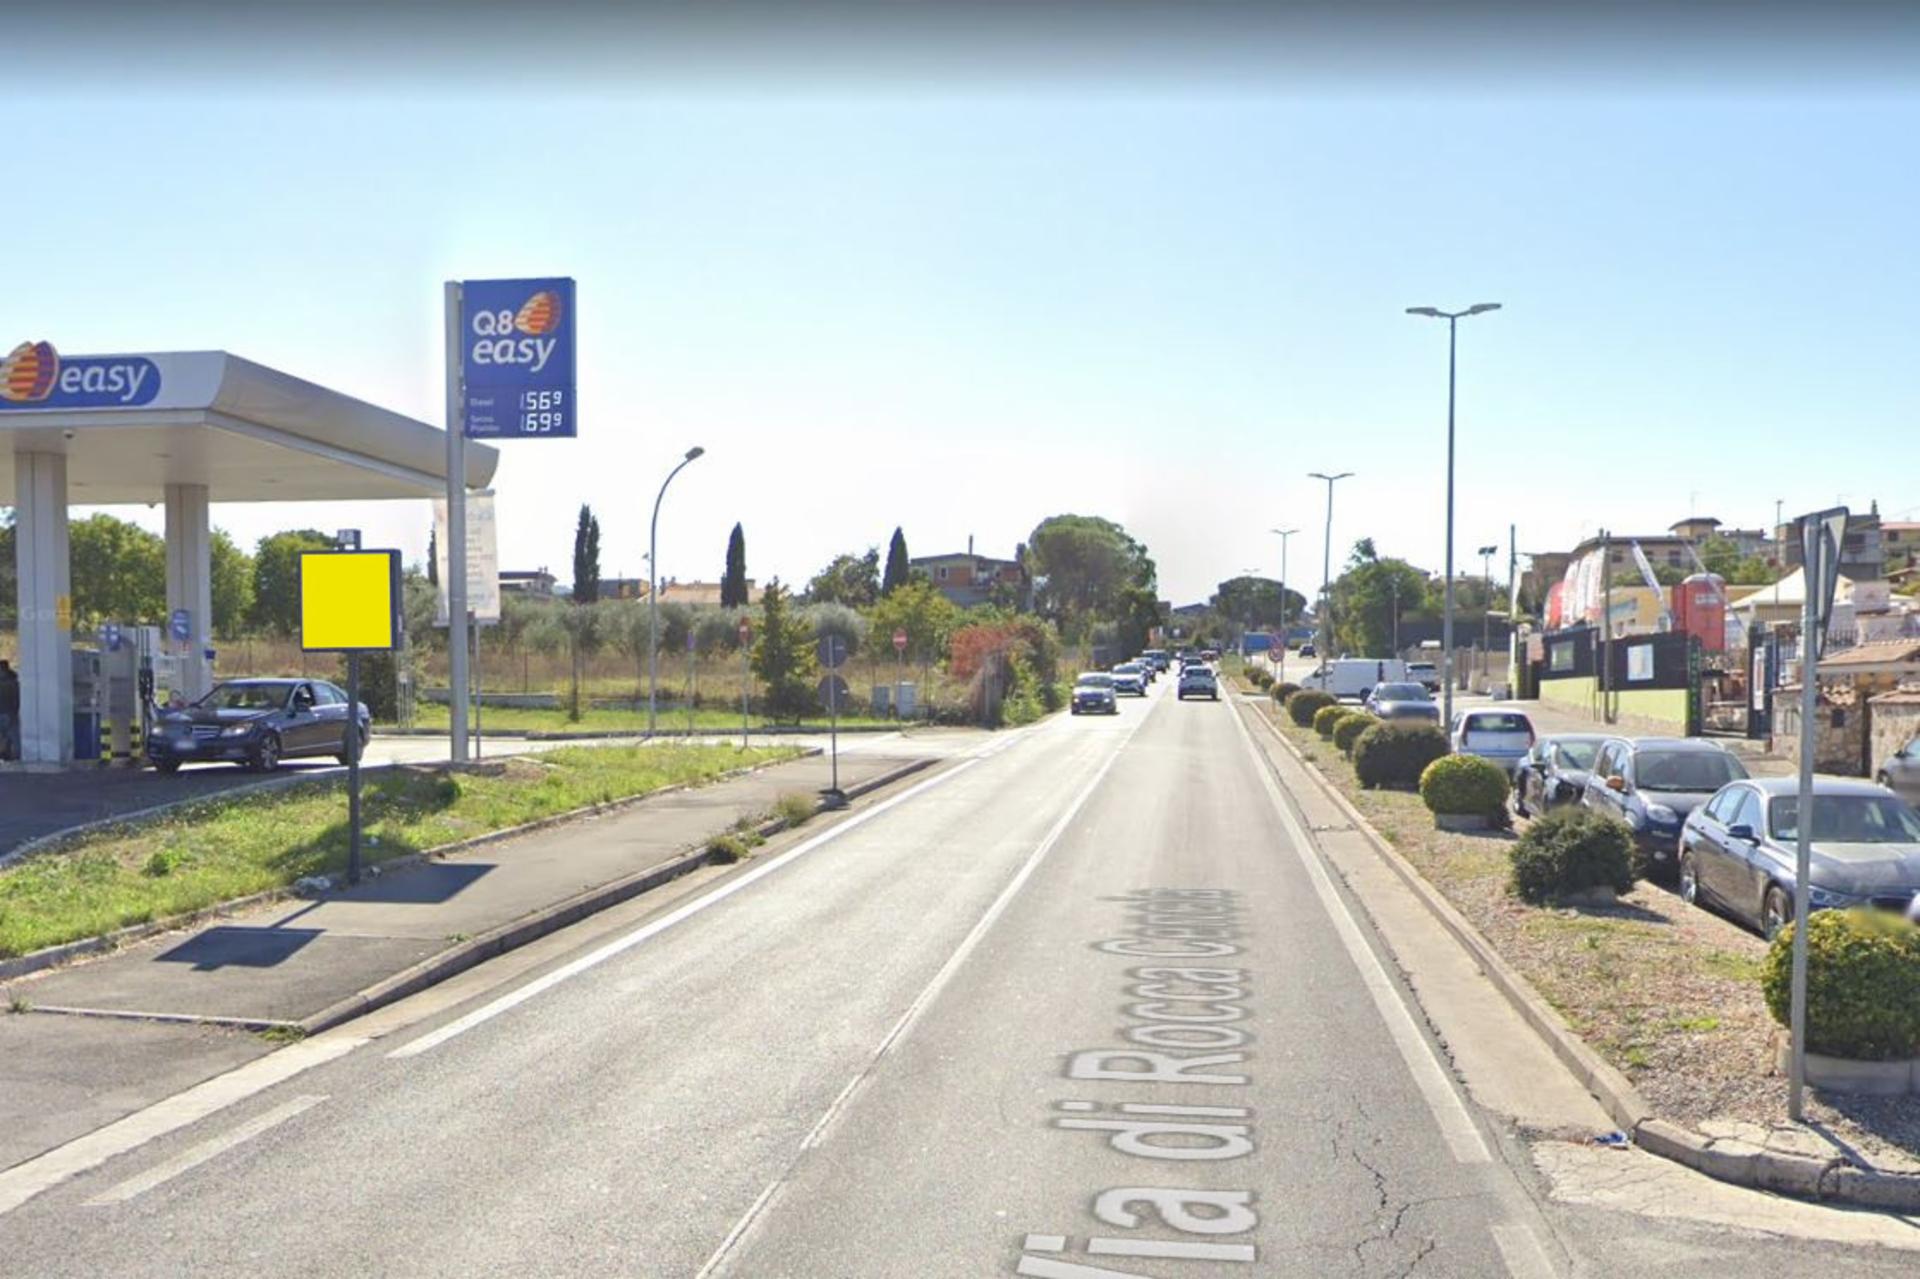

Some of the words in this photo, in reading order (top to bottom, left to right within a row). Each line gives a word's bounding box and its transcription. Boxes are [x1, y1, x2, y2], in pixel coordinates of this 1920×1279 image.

[472, 309, 513, 335] Q8
[472, 337, 556, 373] easy
[59, 364, 149, 403] easy
